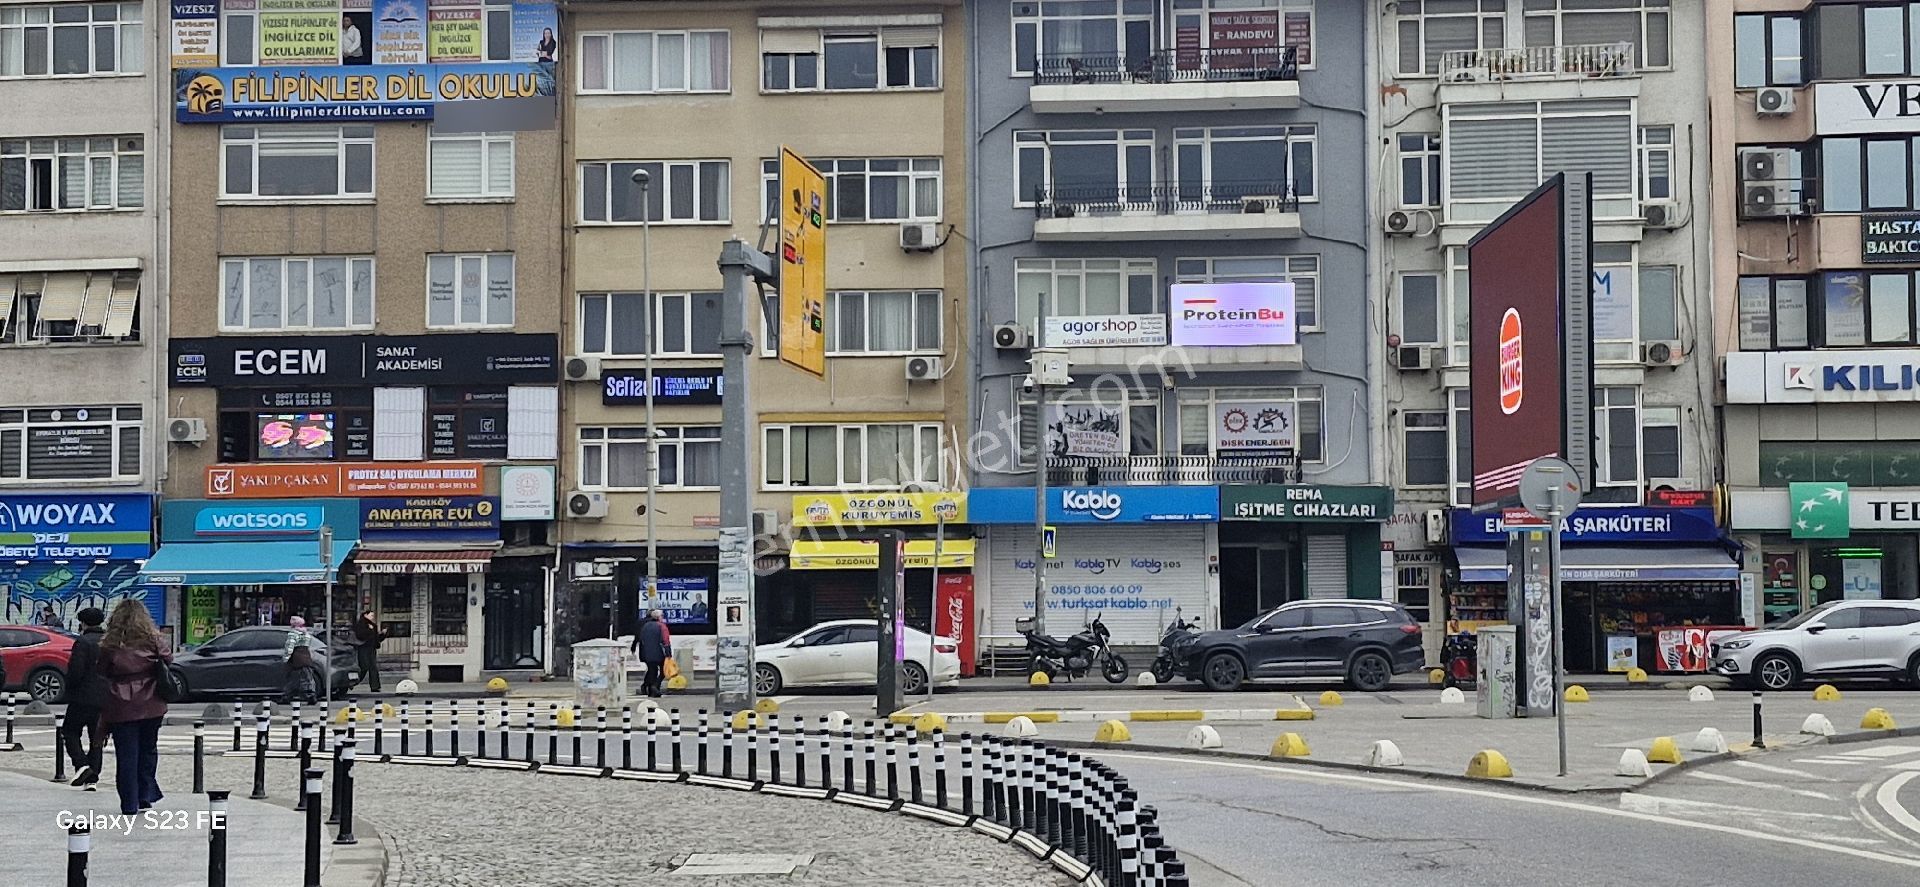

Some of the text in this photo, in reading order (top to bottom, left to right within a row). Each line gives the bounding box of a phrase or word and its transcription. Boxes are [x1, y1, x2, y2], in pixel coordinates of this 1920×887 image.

[264, 30, 335, 42] İNGİLİZCE DİL
[1226, 30, 1274, 40] RANDEVU
[264, 47, 336, 57] OKULLARIMIZ
[232, 68, 538, 103] FİLİPİNLER DİL OKULU
[233, 105, 426, 119] www.filipinlerdilokulu.com
[1868, 221, 1920, 235] HASTA
[1866, 240, 1920, 254] BAKIC
[1183, 308, 1285, 321] ProteinBu
[376, 347, 417, 357] SANAT
[234, 349, 327, 375] ECEM
[376, 357, 442, 370] AKADEMİSİ
[176, 366, 207, 377] ECEM
[1502, 360, 1521, 391] KING
[1822, 364, 1920, 391] KILI
[240, 474, 330, 488] YAKUP ÇAKAN
[348, 469, 379, 480] PROTEZ
[380, 469, 396, 481] SAÇ
[1062, 489, 1122, 510] Kablo
[1286, 489, 1323, 500] REMA
[16, 503, 116, 525] WOYAX
[368, 503, 489, 521] ANAHTAR EVİ 2
[1234, 502, 1285, 518] İŞİTME
[212, 512, 308, 528] watsons
[1573, 514, 1671, 536] ŞARKÜTERİ
[43, 546, 112, 556] TELEFONCU
[1395, 555, 1421, 564] ŞAFAK
[413, 563, 461, 573] ANAHTAR
[192, 589, 214, 598] LOOK
[1052, 584, 1143, 595] 0850 806 60 09
[192, 599, 216, 607] GOOD
[642, 592, 689, 601] STILIK
[1022, 597, 1172, 610] ww.turksatkablo.net
